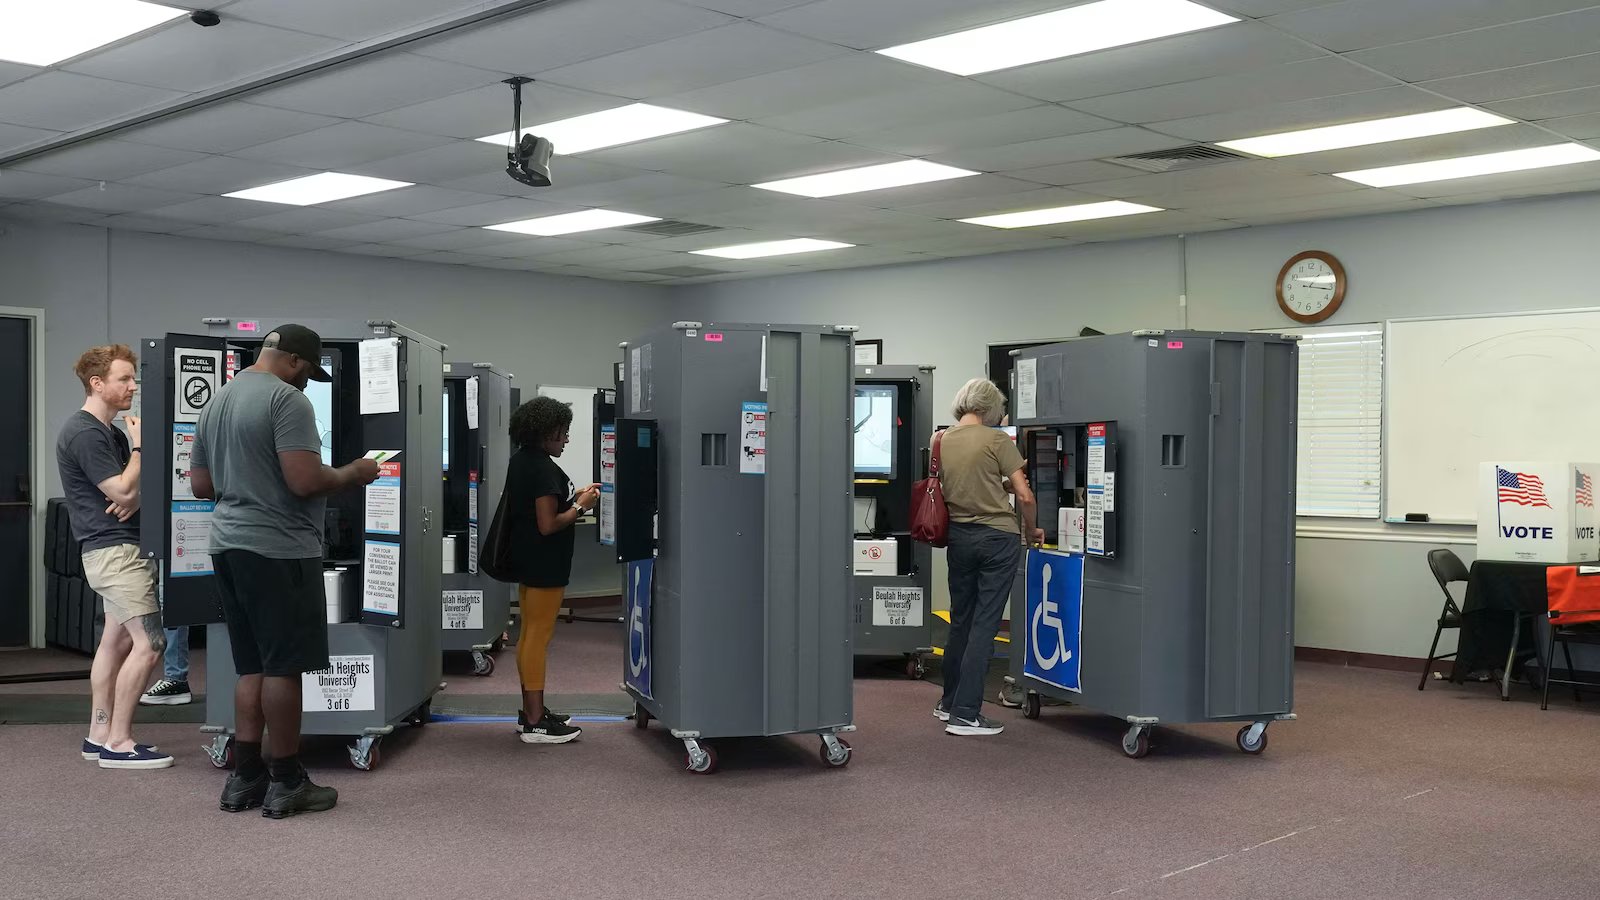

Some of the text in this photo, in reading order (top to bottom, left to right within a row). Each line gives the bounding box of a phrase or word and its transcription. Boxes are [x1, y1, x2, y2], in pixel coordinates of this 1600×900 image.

[1306, 303, 1311, 311] 6
[1502, 526, 1553, 539] VOTE
[1576, 527, 1594, 539] VOTE
[443, 595, 480, 604] ulah Heights
[876, 591, 920, 602] Beulah Heights
[445, 604, 471, 614] University
[884, 600, 911, 610] University
[336, 662, 370, 676] Heights
[318, 674, 357, 688] University
[328, 699, 349, 710] 3 of 6
